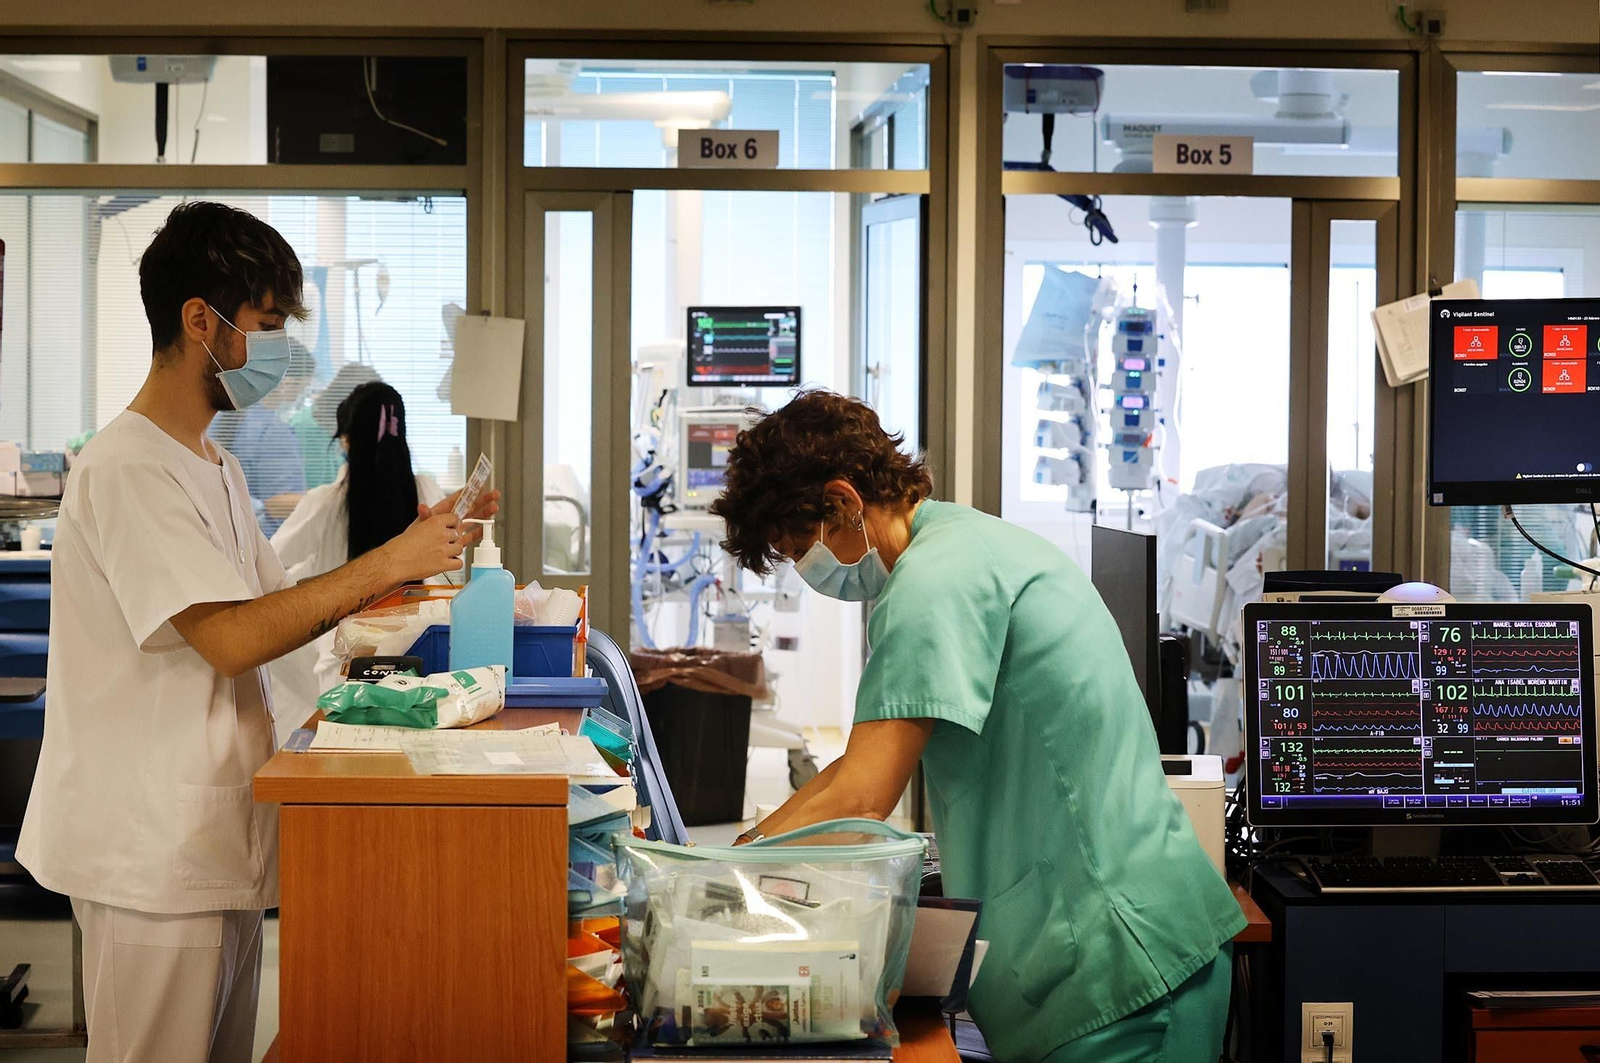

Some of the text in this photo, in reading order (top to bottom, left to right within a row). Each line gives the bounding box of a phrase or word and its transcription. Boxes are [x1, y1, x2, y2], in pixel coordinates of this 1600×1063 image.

[700, 137, 757, 159] Box 6
[1176, 143, 1232, 165] Box 5
[1281, 626, 1297, 636] 88
[1440, 627, 1461, 642] 76
[1274, 666, 1286, 676] 89
[1435, 666, 1446, 676] 99
[1275, 685, 1304, 700] 101
[1437, 685, 1468, 700] 102
[1283, 708, 1299, 718] 80
[1437, 724, 1468, 734] 32 99
[1280, 742, 1303, 752] 132
[1274, 782, 1290, 792] 132
